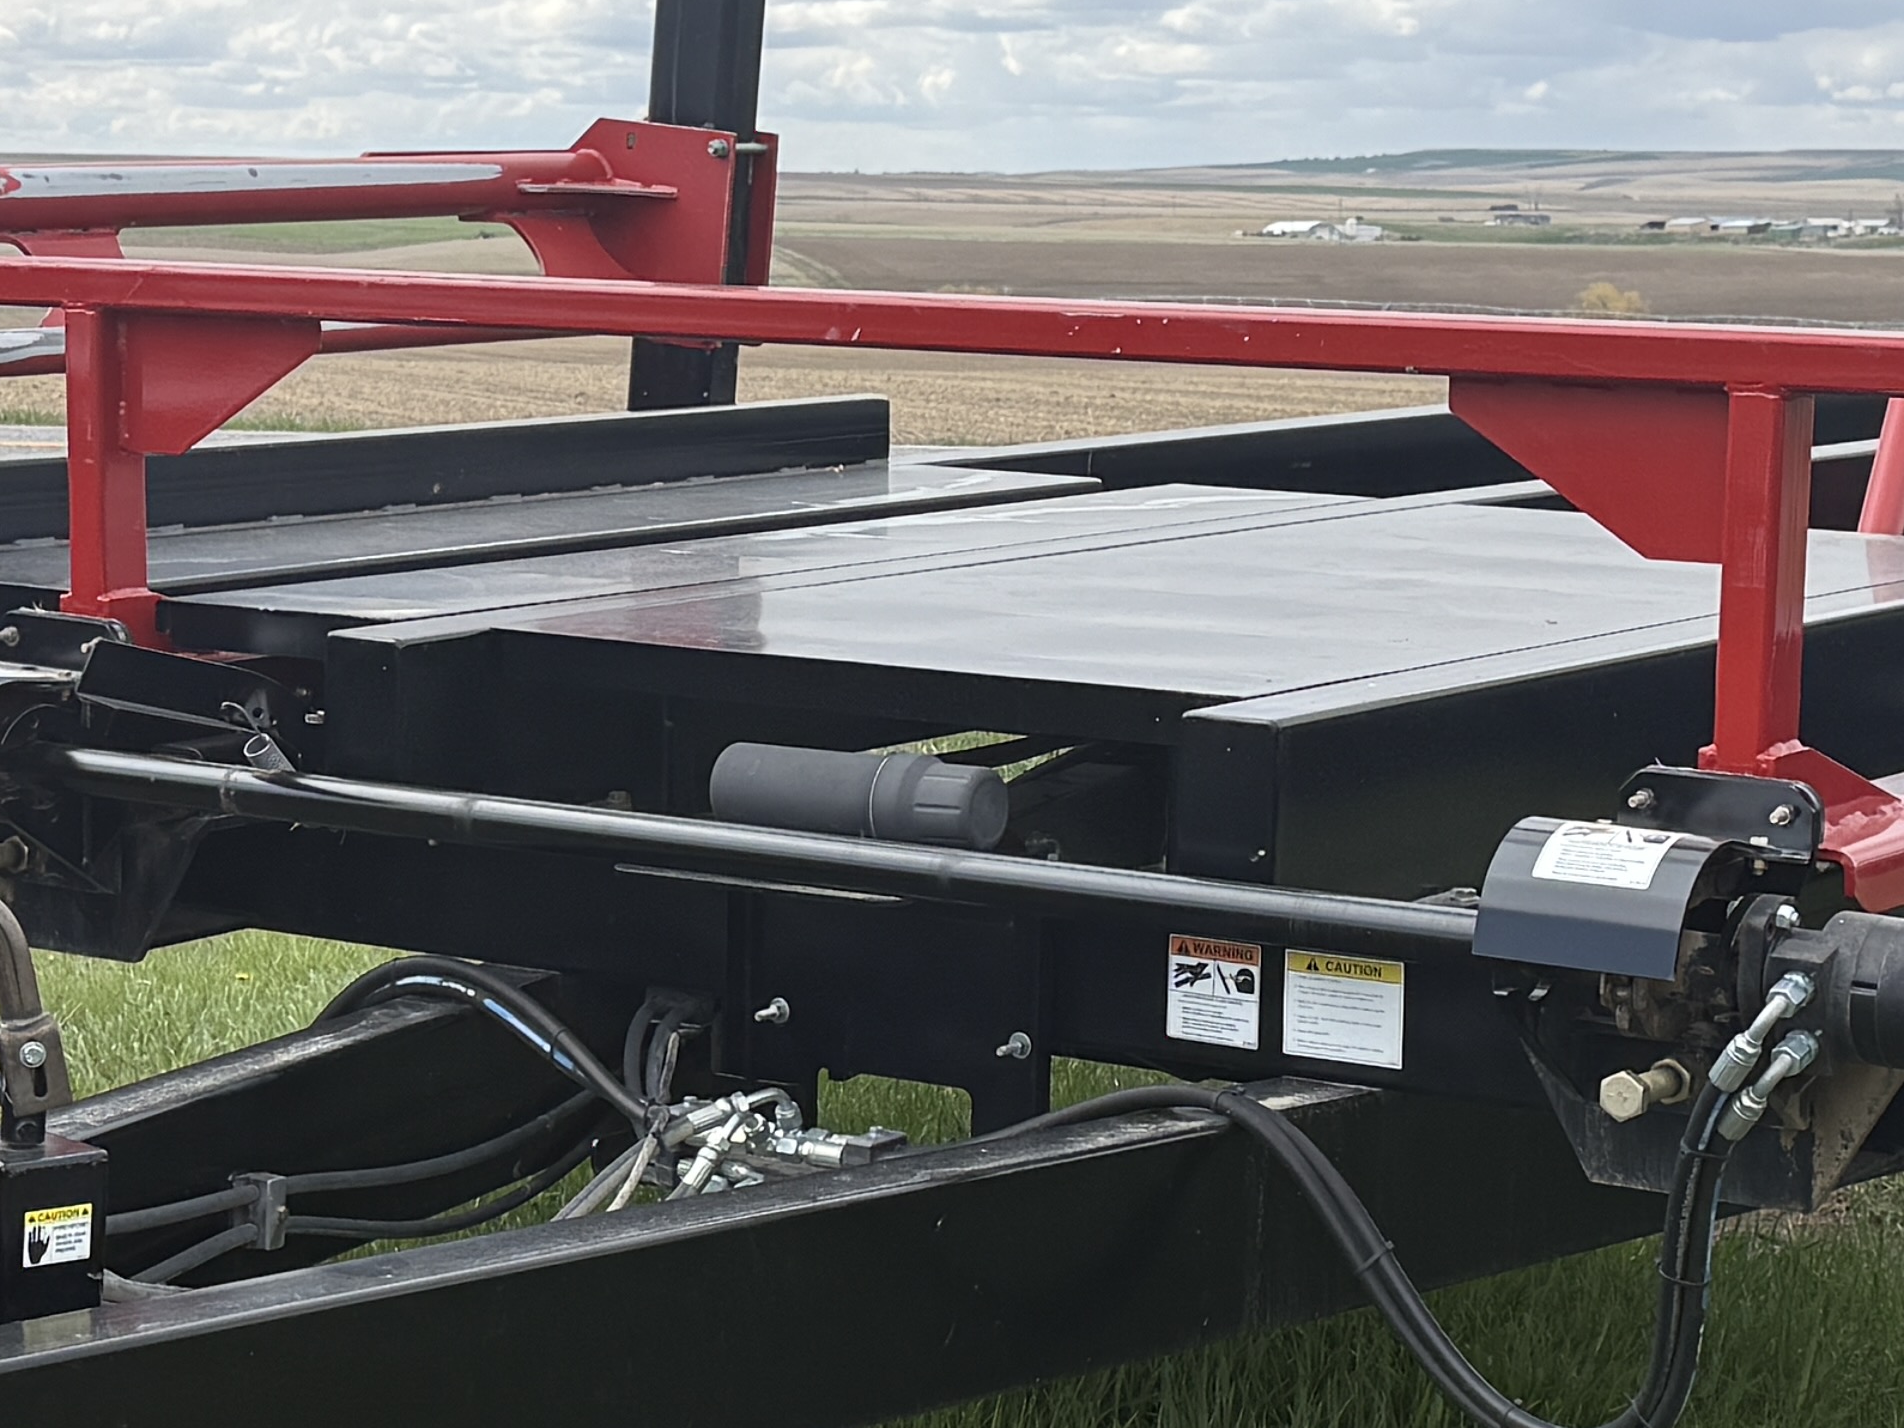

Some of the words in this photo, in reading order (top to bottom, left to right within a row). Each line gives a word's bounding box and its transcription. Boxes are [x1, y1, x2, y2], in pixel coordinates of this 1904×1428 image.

[1192, 942, 1254, 961] WARNING
[1324, 960, 1383, 979] CAUTION
[37, 1208, 80, 1222] CAUTION
